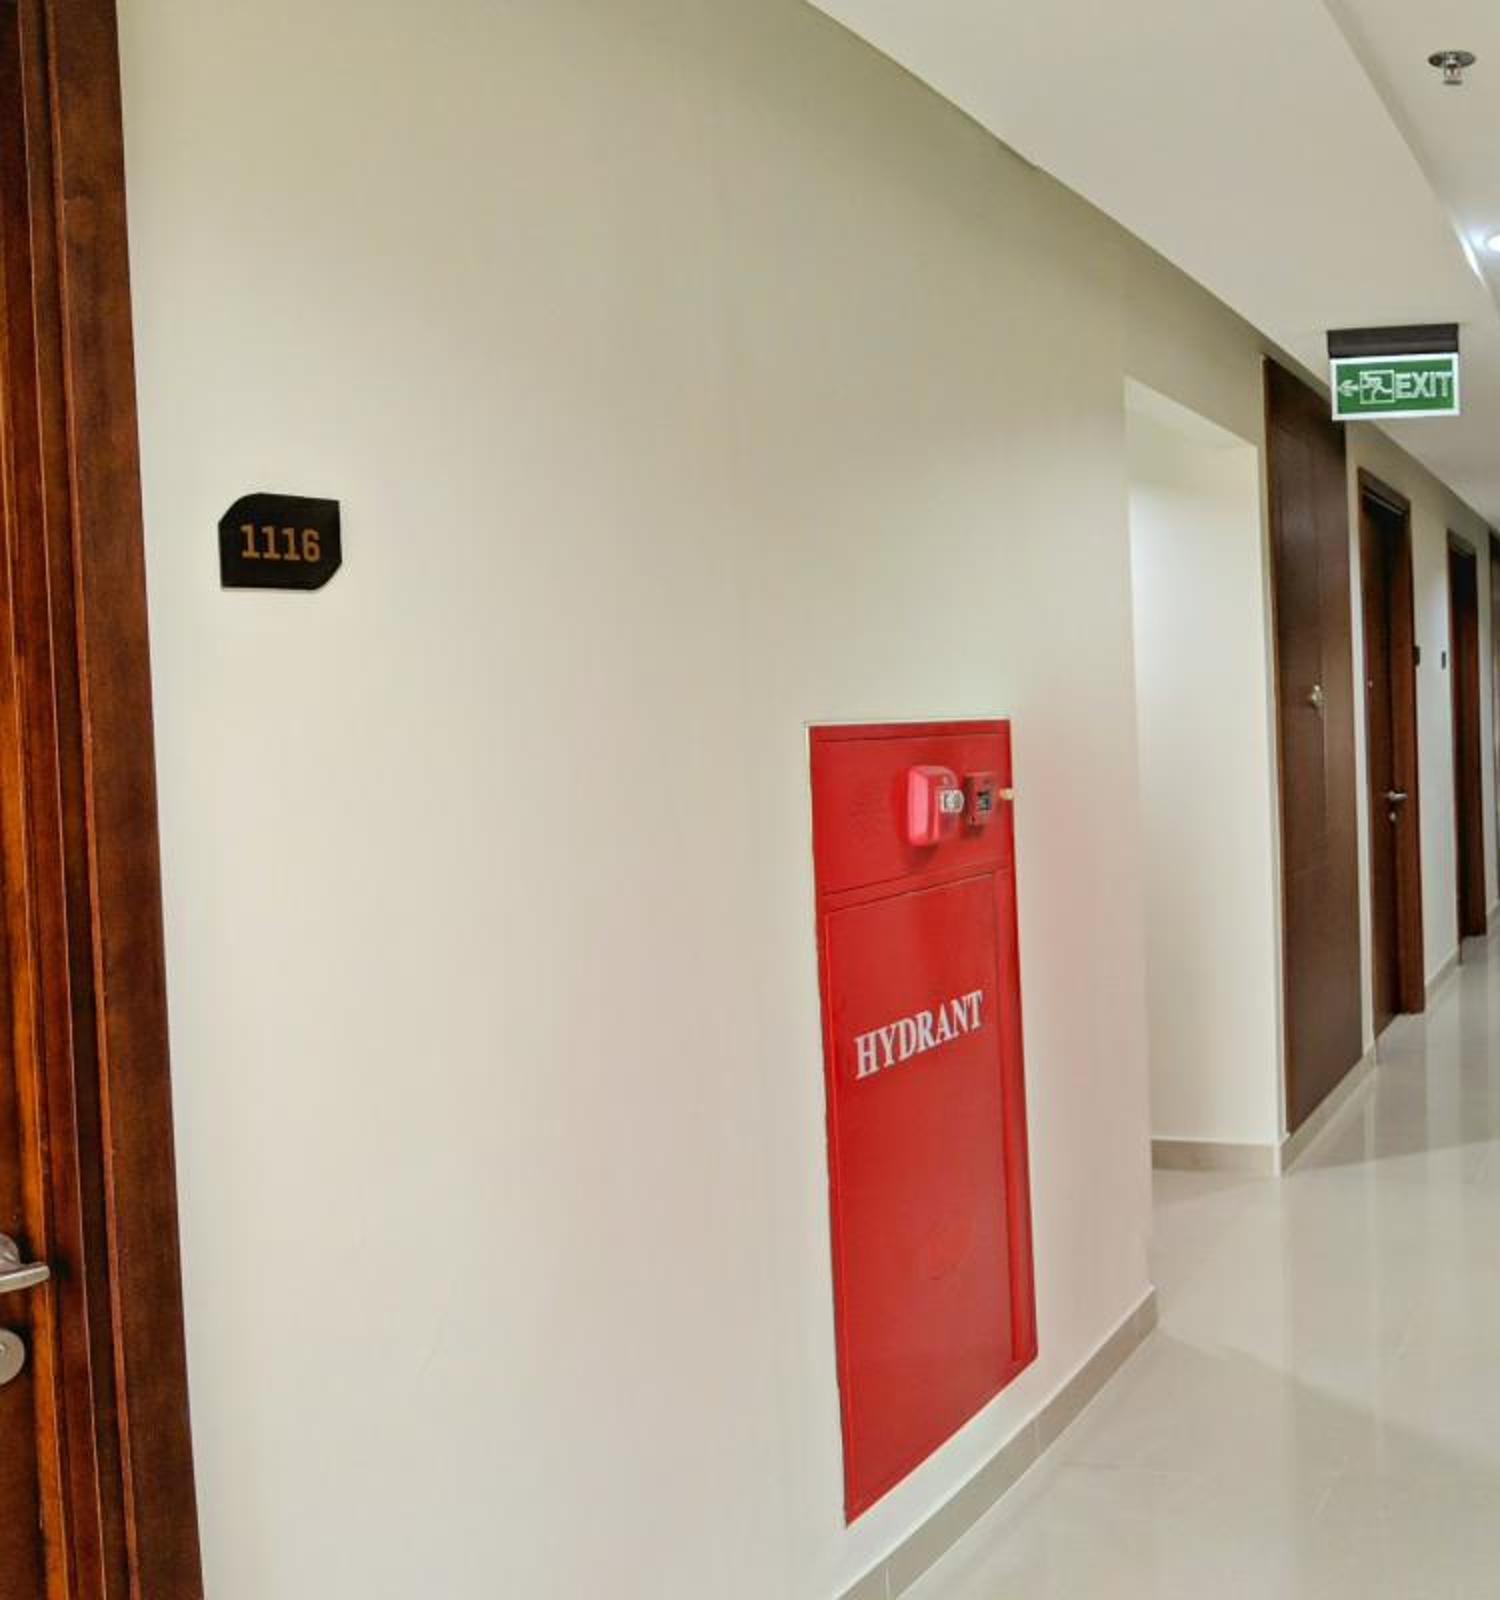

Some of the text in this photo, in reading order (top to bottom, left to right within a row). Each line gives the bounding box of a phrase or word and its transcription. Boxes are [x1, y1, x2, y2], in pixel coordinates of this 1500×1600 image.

[1395, 371, 1453, 399] EXIT
[240, 523, 321, 562] 1116
[854, 989, 983, 1080] HYDRANT
